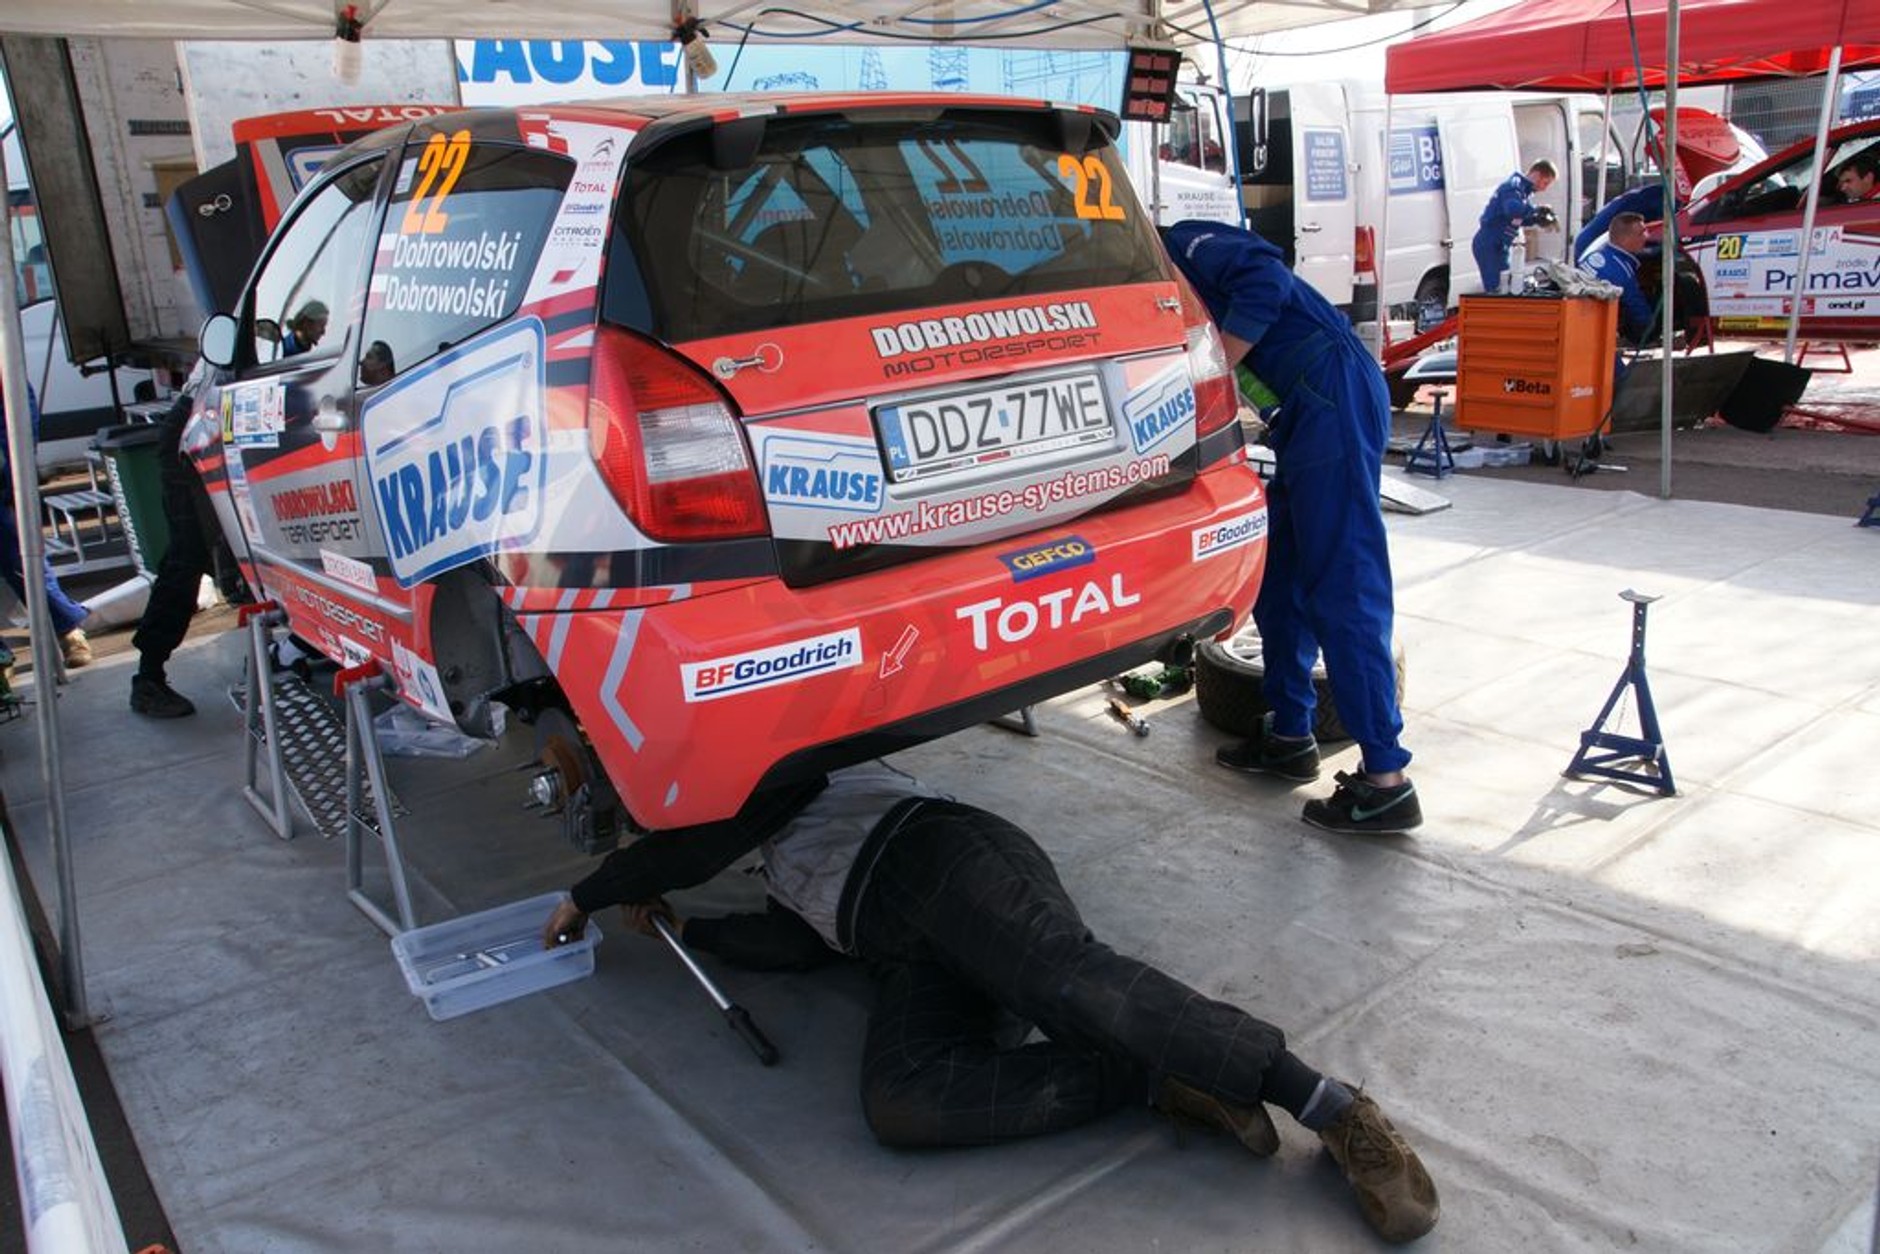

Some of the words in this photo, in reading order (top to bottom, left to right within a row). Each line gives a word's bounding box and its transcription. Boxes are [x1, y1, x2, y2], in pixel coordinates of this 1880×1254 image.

[458, 39, 676, 86] AUSE
[402, 130, 472, 235] 22
[573, 182, 606, 193] TOTAL
[1058, 153, 1126, 221] 22
[393, 230, 522, 271] Dobrowolski
[1718, 236, 1741, 259] 20
[385, 274, 509, 318] Dobrowolski
[1765, 269, 1880, 291] Prmav
[1828, 300, 1866, 310] onet.pl
[870, 301, 1098, 358] DOBROWOLSKI
[884, 333, 1100, 378] MOTORSPORT
[1515, 379, 1551, 395] Beta
[907, 399, 1002, 460] DDZ
[1007, 380, 1103, 440] 77WE
[1134, 388, 1195, 447] KRAUSE
[889, 446, 907, 459] PL
[378, 414, 533, 559] KRAUSE
[768, 464, 879, 503] KRAUSE
[829, 453, 1170, 551] www.krause-systems.com
[1199, 514, 1266, 550] BFGoodrich
[1012, 542, 1085, 570] GEFCO
[955, 572, 1141, 651] TOTAL
[694, 637, 853, 690] BFGoodrich
